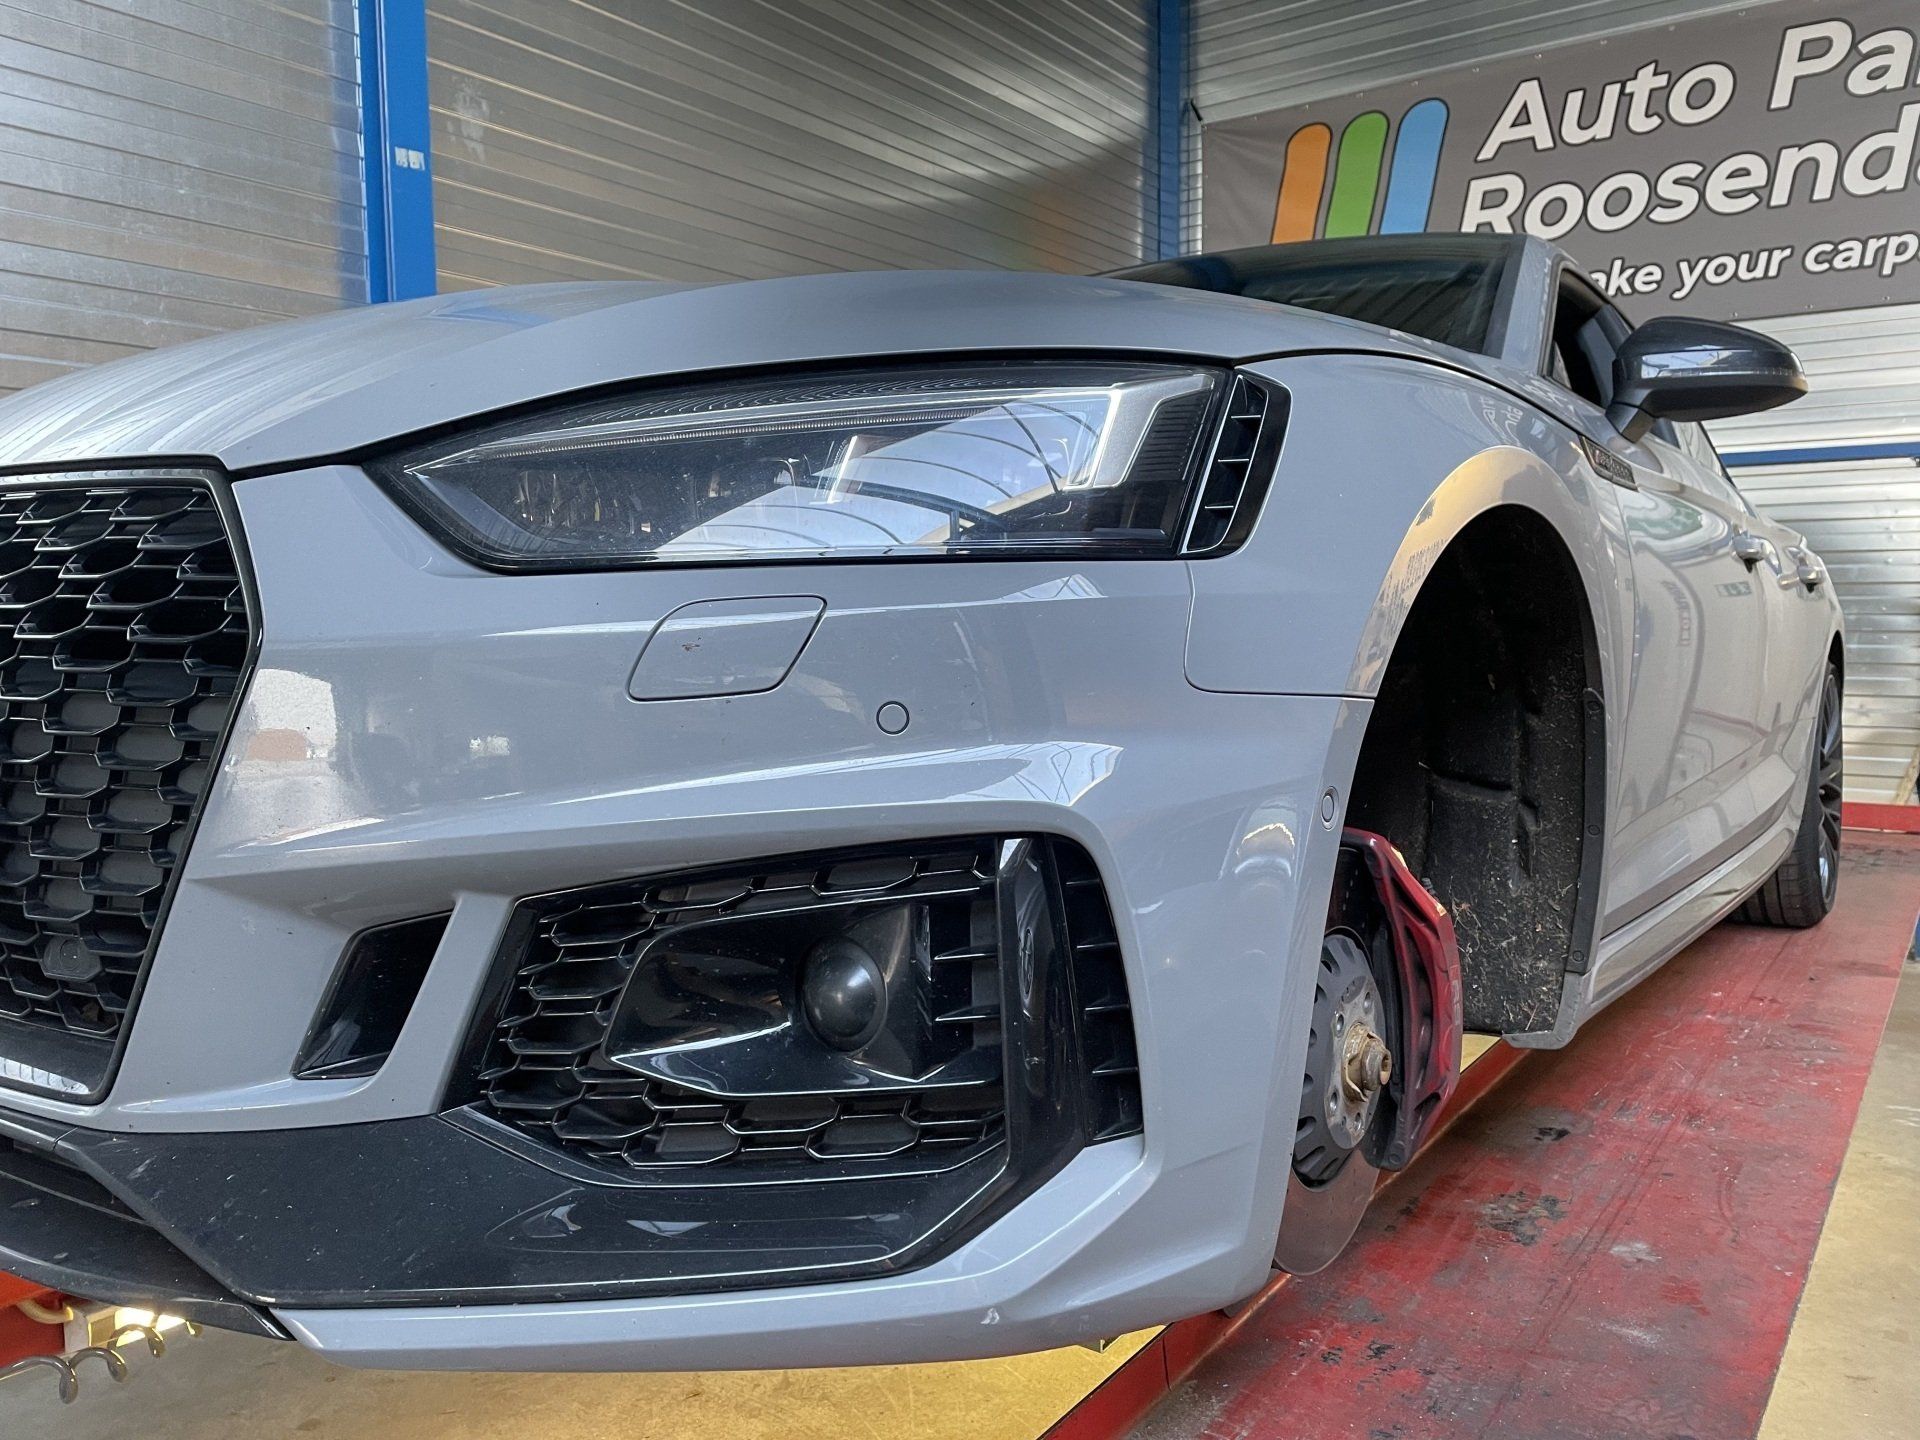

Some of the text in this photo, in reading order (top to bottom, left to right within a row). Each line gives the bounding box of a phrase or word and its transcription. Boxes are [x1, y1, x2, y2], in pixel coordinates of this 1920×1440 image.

[1475, 20, 1920, 161] Auto Pa
[1460, 103, 1920, 241] Roosend
[1671, 247, 1793, 300] your
[1804, 233, 1920, 275] carp
